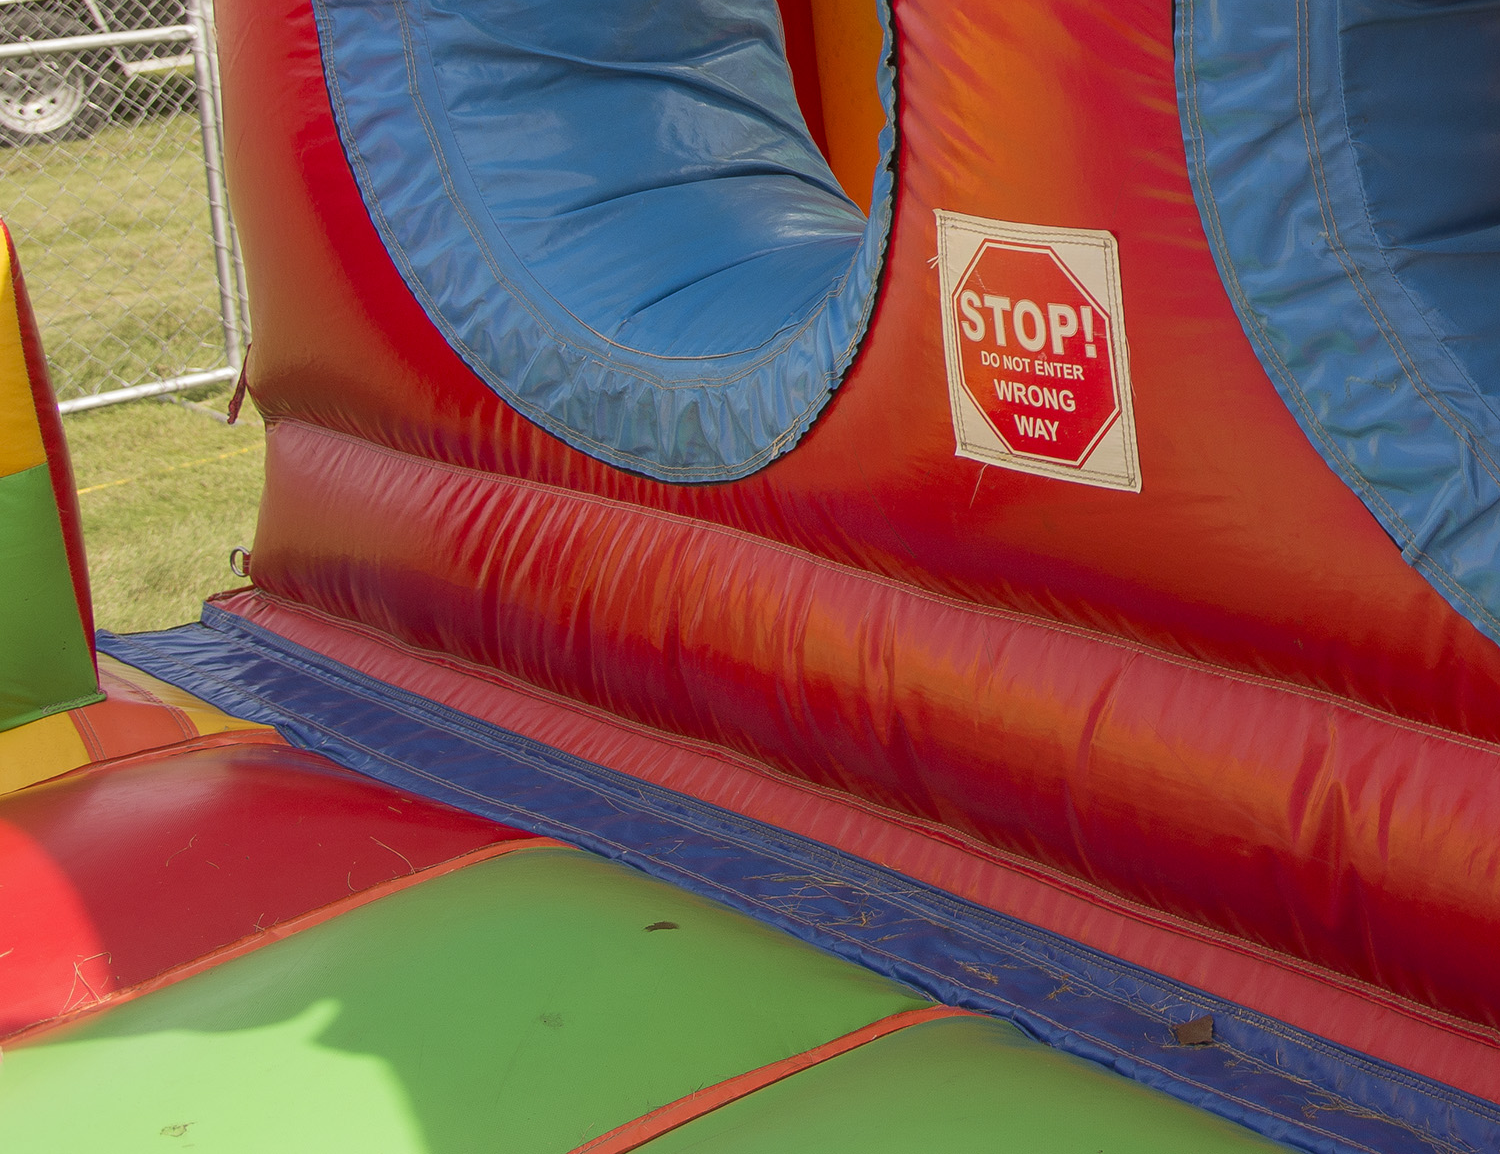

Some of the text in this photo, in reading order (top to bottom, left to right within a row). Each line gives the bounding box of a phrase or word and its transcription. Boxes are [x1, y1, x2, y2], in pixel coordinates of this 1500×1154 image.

[960, 290, 1097, 358] STOP!
[981, 351, 1084, 380] DO NOT ENTER
[994, 378, 1076, 412] WRONG
[1014, 415, 1059, 441] WAY
